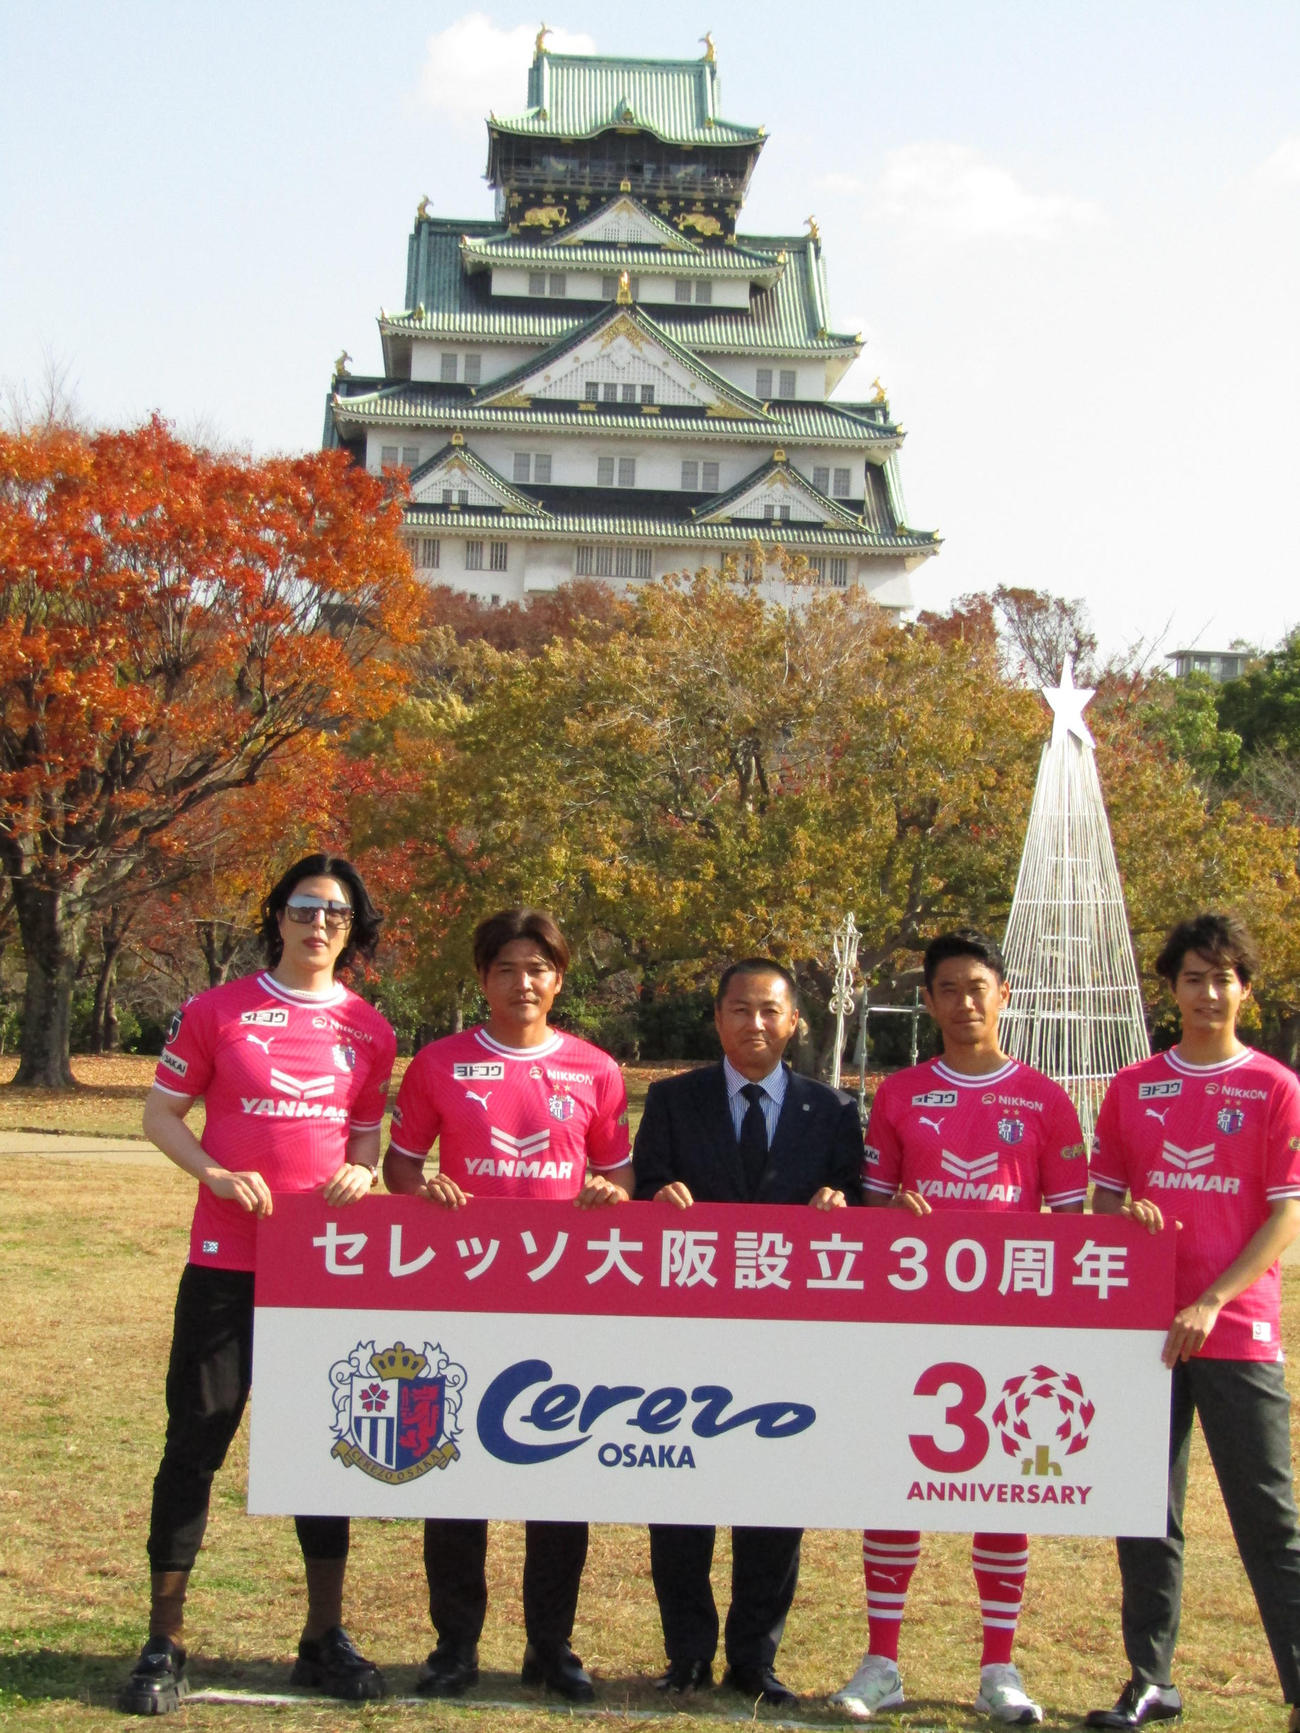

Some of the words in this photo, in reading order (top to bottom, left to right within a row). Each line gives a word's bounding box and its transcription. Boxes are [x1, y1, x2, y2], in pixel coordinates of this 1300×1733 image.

[455, 1065, 502, 1077] ヨドコウ
[547, 1069, 594, 1086] NIKKON
[1140, 1081, 1181, 1096] ヨドコウ
[1221, 1085, 1268, 1100] NIKKON
[998, 1095, 1044, 1112] NIKKON
[464, 1157, 574, 1179] YANMAR
[916, 1179, 1022, 1202] YANMAR
[476, 1358, 817, 1465] Cerezo
[598, 1442, 697, 1469] OSAKA
[906, 1480, 1093, 1505] ANNIVERSARY
